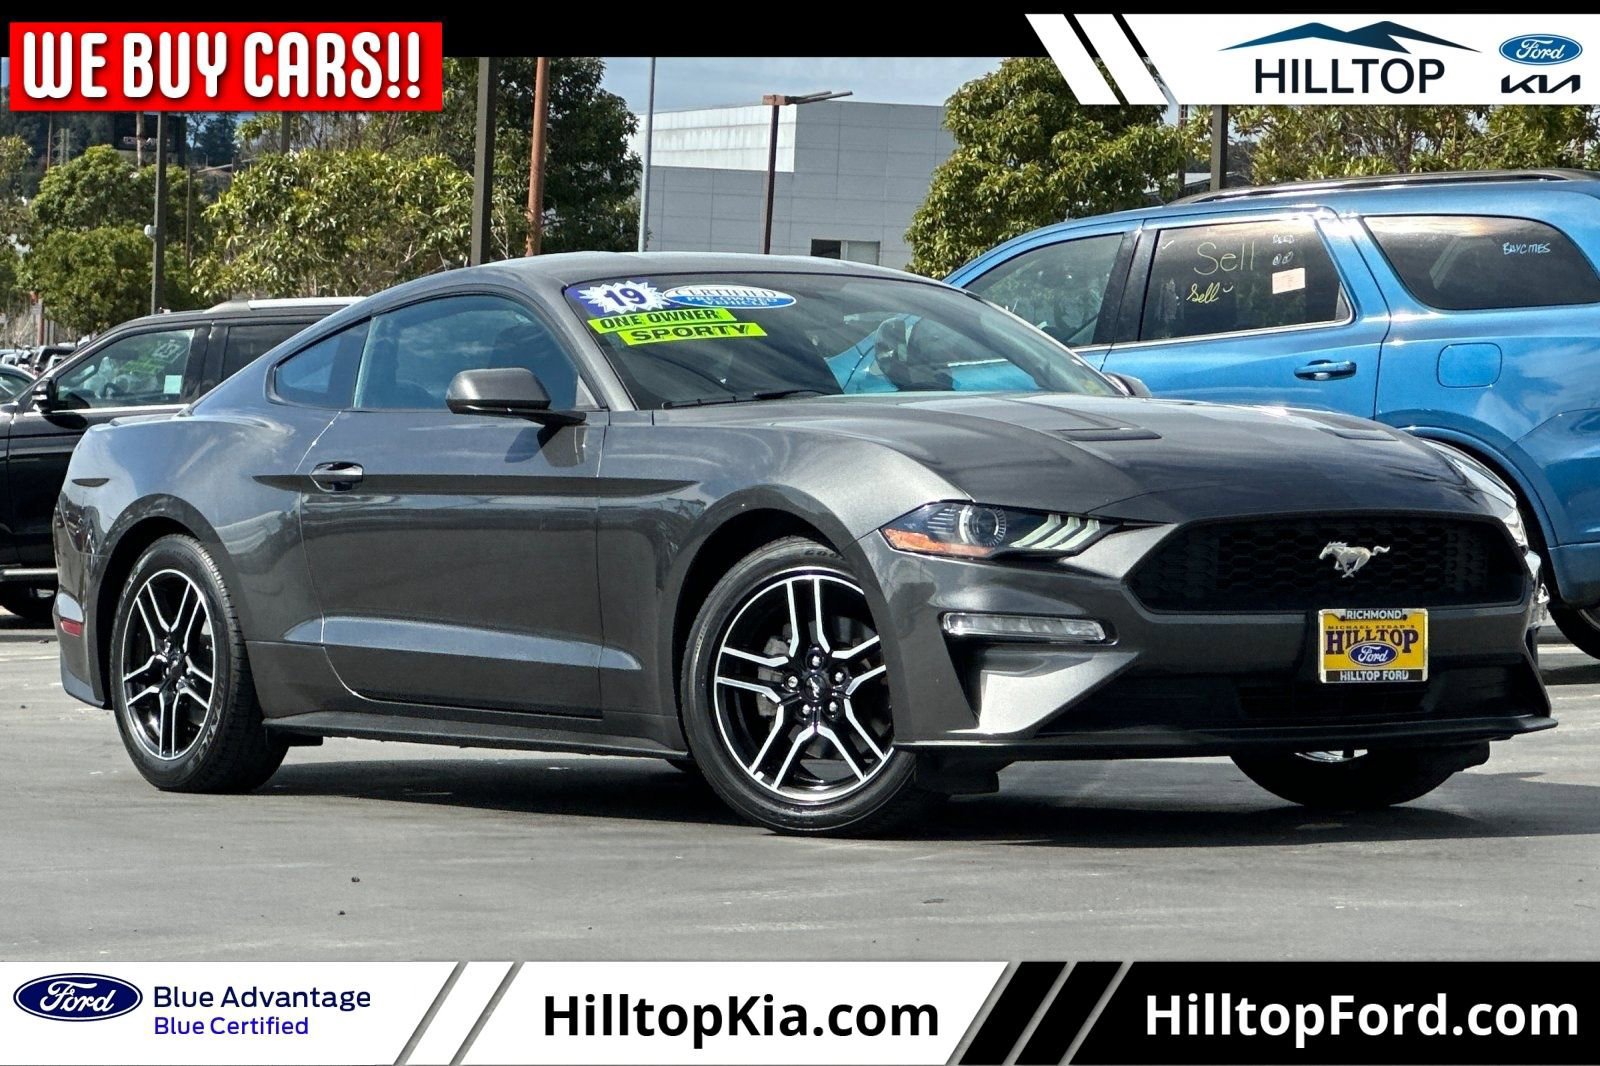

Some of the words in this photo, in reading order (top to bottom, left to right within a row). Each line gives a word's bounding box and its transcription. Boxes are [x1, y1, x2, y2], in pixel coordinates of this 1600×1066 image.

[1193, 241, 1255, 276] Sell
[603, 287, 647, 307] 19
[600, 313, 643, 329] ONE
[649, 309, 718, 324] OWNER
[630, 324, 749, 342] SPORTY
[1346, 610, 1402, 620] RICHMOND
[1325, 629, 1419, 655] HILLTOP
[1358, 645, 1389, 662] Ford
[1340, 671, 1380, 681] HILLTOP
[1382, 670, 1409, 680] FORD
